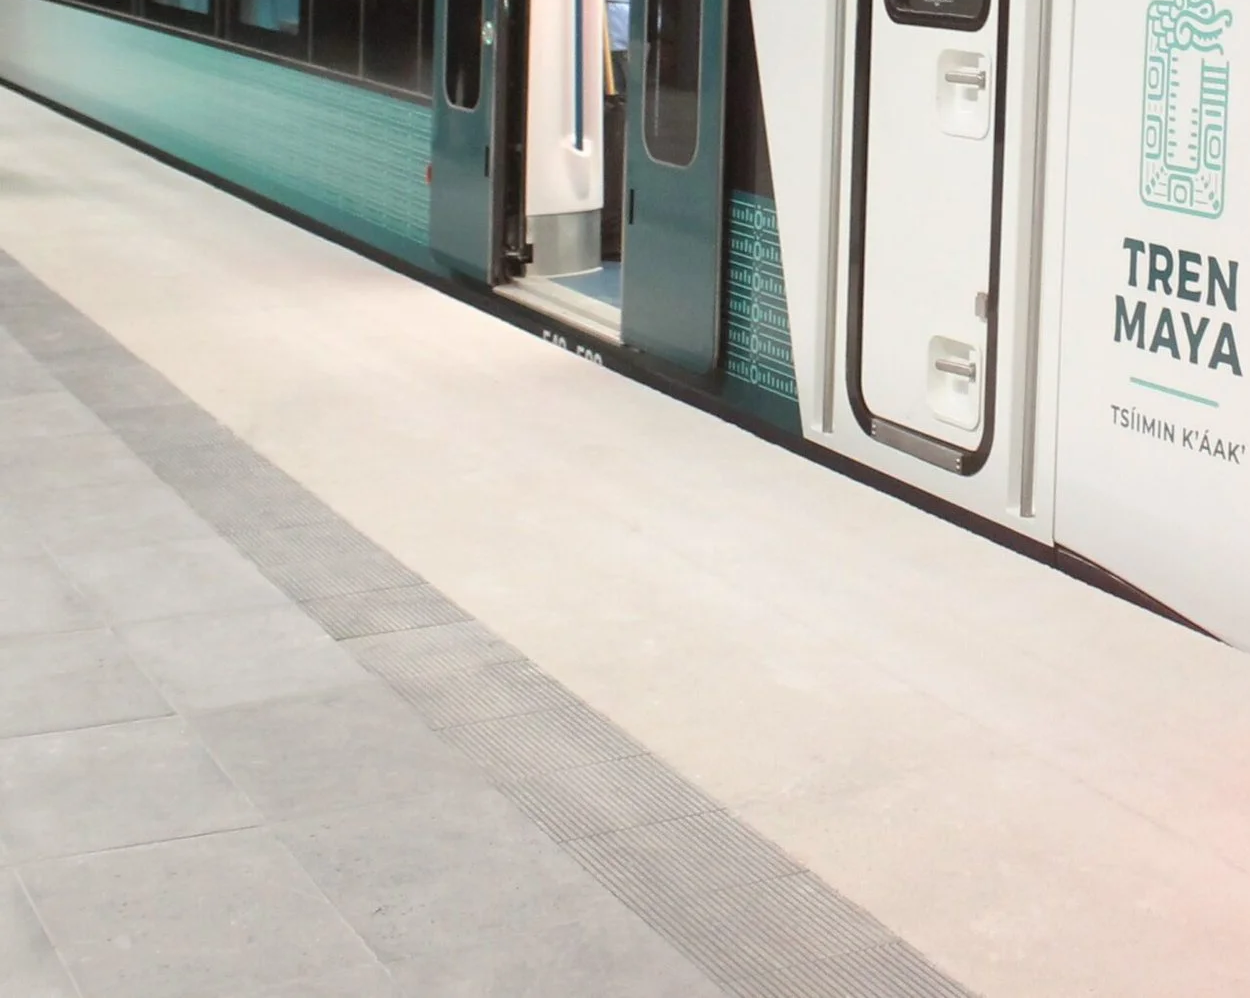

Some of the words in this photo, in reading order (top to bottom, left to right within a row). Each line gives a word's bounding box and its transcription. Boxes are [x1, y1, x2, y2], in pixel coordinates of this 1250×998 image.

[1122, 236, 1240, 312] TREN
[1113, 294, 1244, 378] MAYA
[1110, 404, 1176, 443] TSÍIMIN
[1182, 428, 1246, 465] K'ÁAK'
